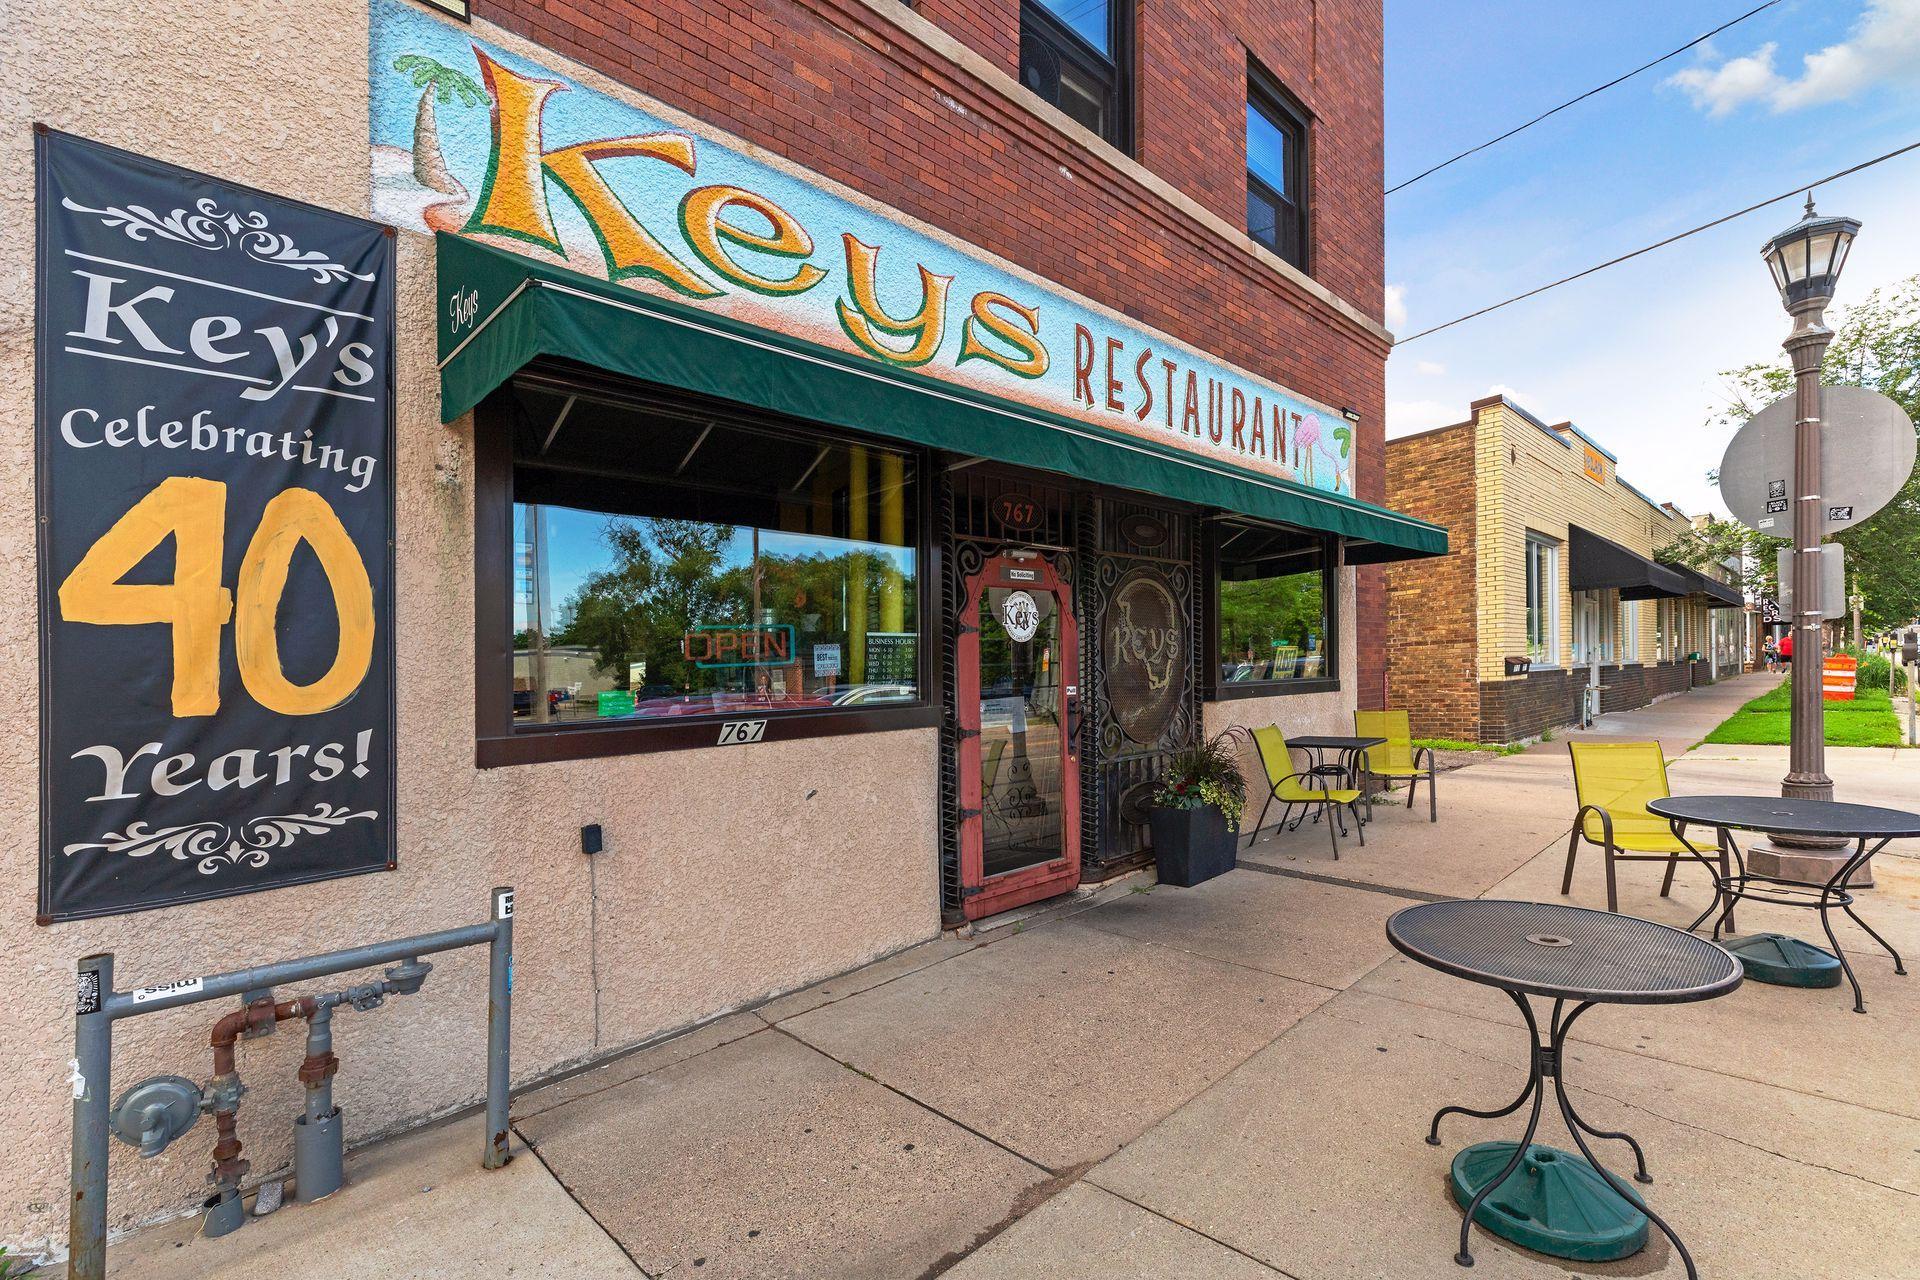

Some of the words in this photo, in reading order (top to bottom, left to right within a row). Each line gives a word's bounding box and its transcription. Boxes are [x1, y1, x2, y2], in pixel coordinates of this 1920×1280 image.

[459, 40, 1051, 379] Keys
[1073, 322, 1303, 470] RESTAURANT
[64, 268, 376, 402] Key's
[449, 285, 479, 334] Keys
[59, 404, 378, 493] Celebrating
[1002, 501, 1034, 524] 767
[57, 475, 376, 718] 40
[1003, 604, 1039, 631] Keys
[685, 631, 787, 661] OPEN
[721, 721, 766, 743] 767
[70, 727, 374, 802] Years!
